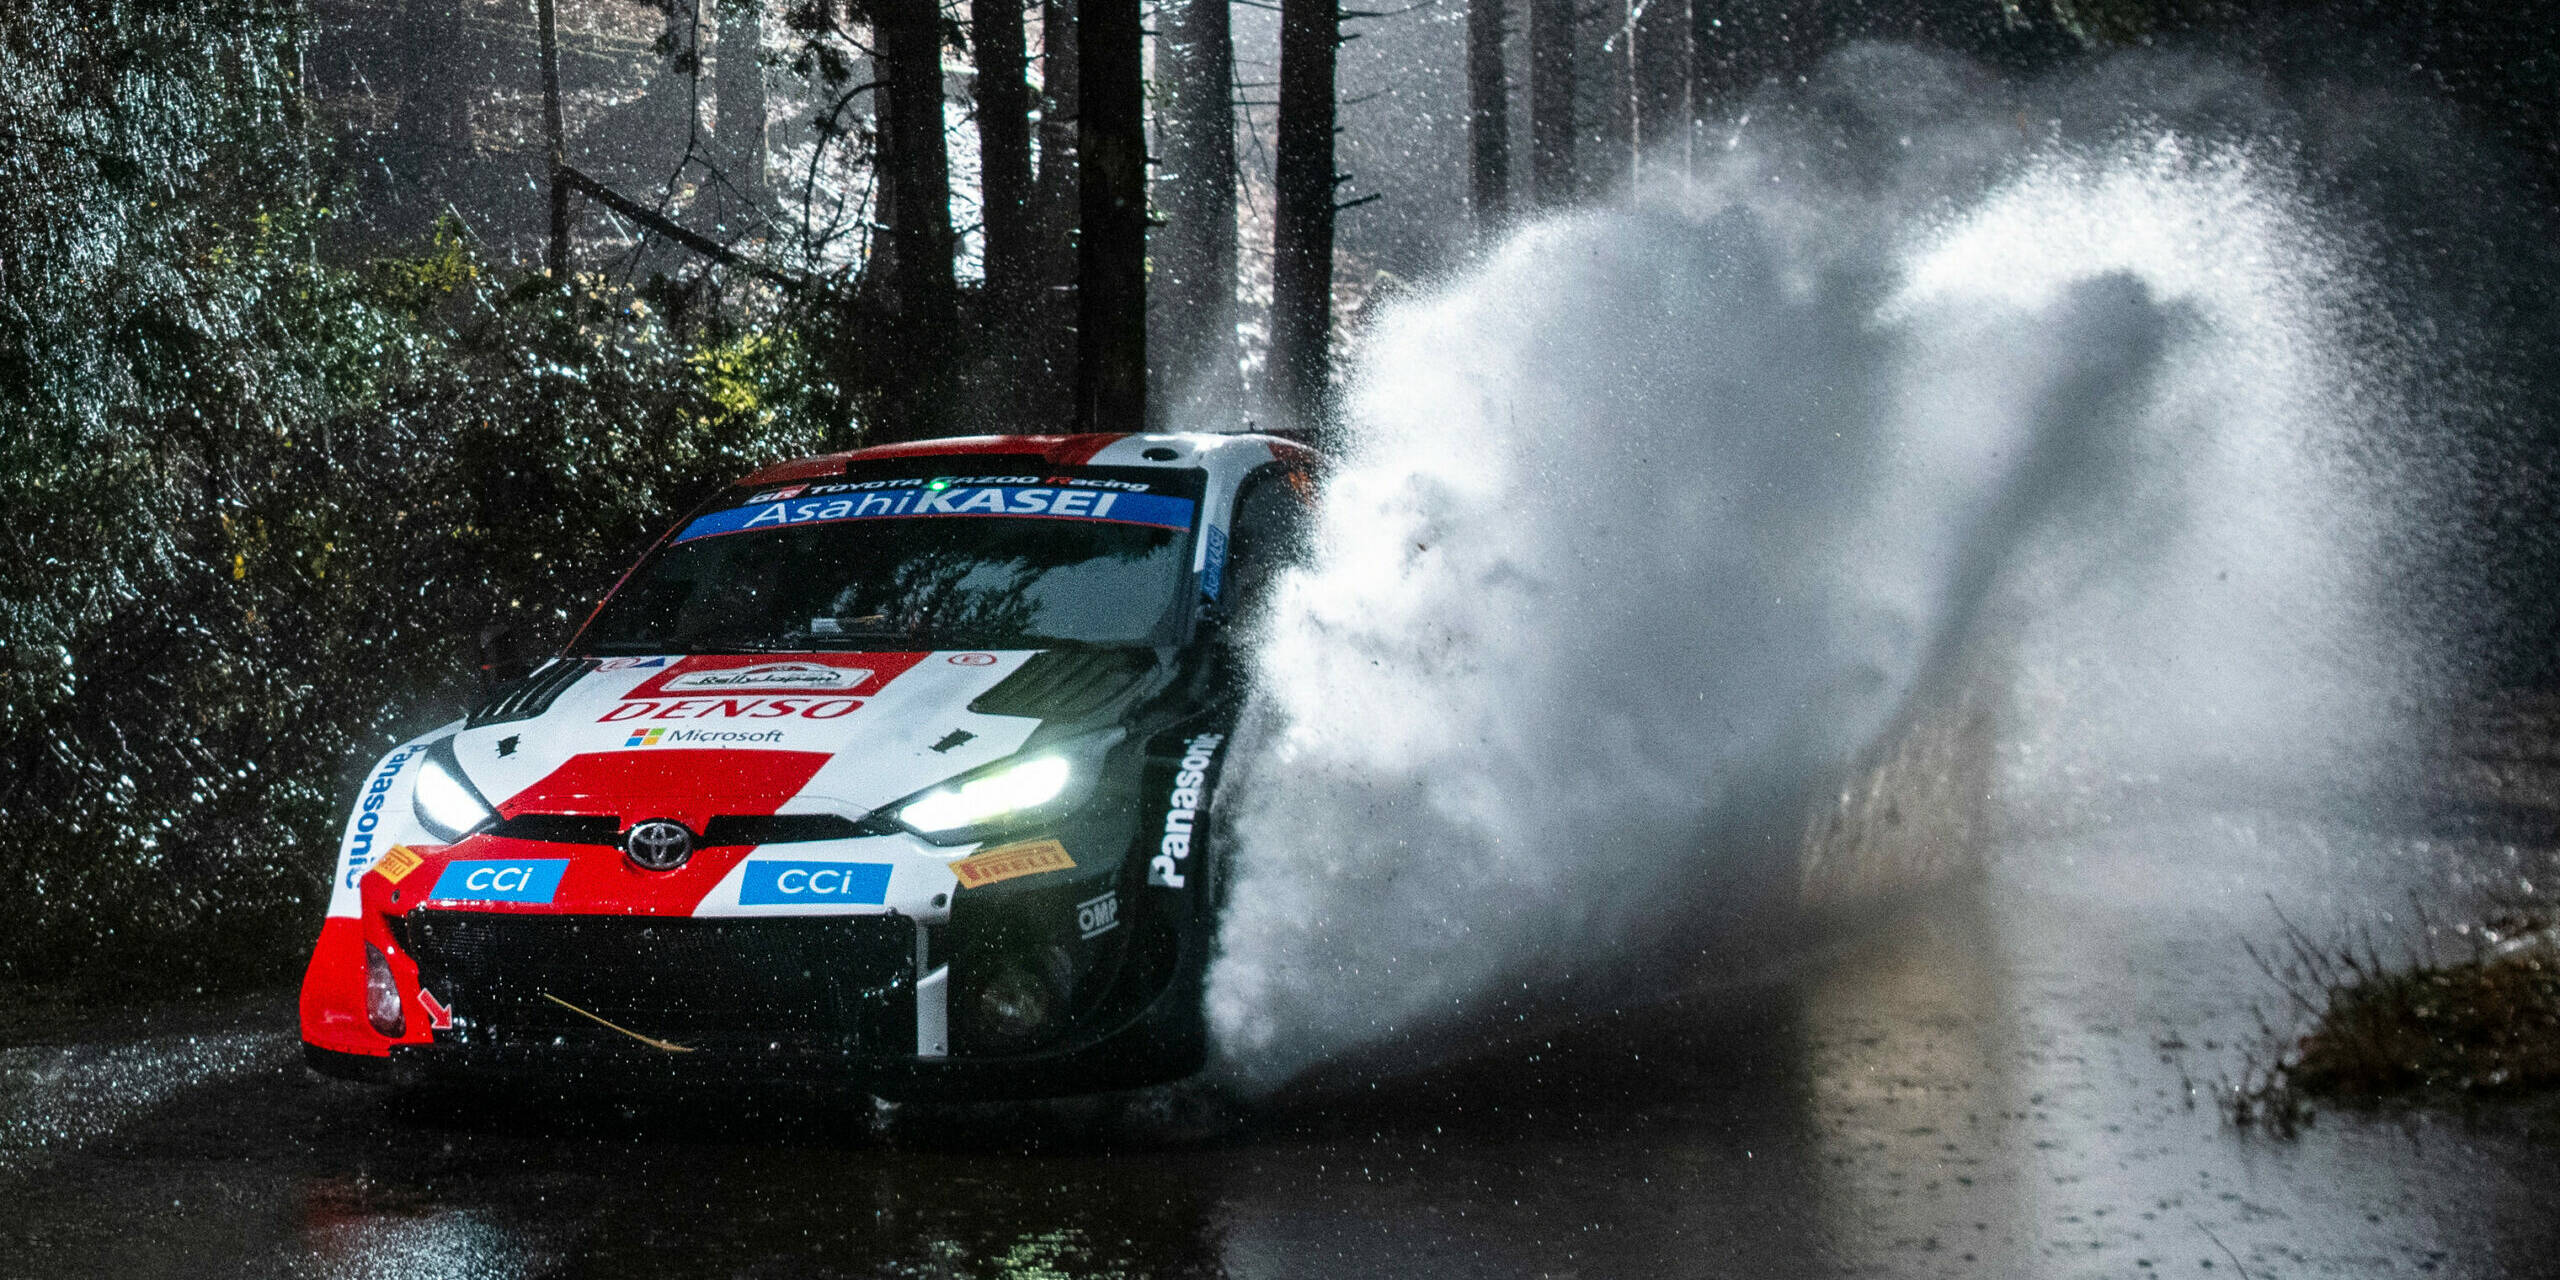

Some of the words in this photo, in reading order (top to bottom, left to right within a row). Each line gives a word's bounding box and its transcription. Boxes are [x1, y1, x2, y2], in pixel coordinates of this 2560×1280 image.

[811, 478, 923, 495] TOYOTA
[1046, 476, 1151, 492] Racing
[596, 699, 865, 723] DENSO
[668, 729, 785, 743] Microsoft
[466, 867, 534, 892] CCi
[777, 869, 853, 894] CCi
[1078, 897, 1118, 932] OMP
